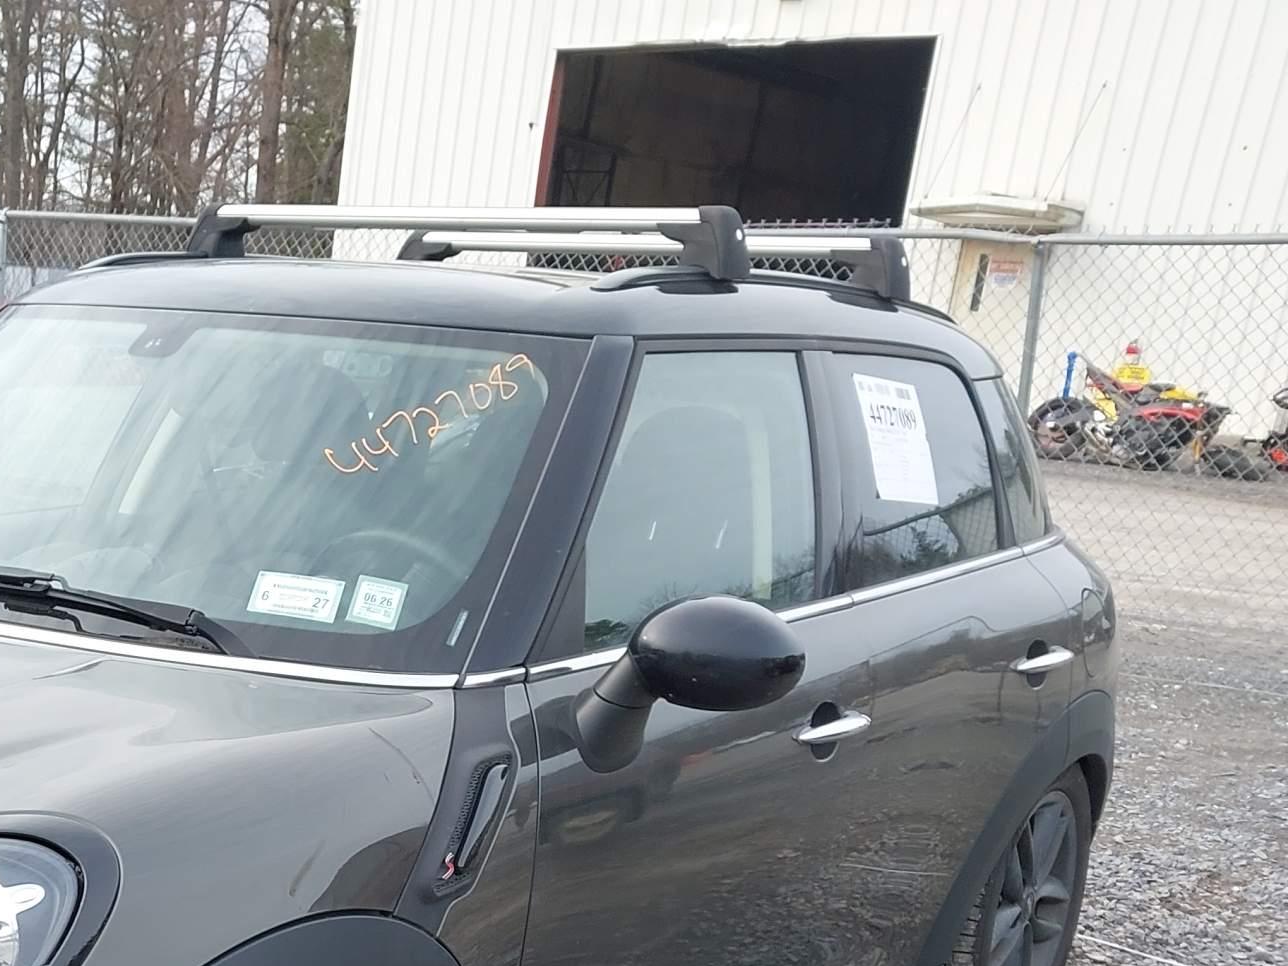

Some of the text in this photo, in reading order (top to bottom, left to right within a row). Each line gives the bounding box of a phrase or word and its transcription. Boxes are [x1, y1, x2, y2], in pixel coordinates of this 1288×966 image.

[324, 353, 535, 473] 44727089
[869, 402, 918, 430] 44727089
[312, 597, 330, 609] 27
